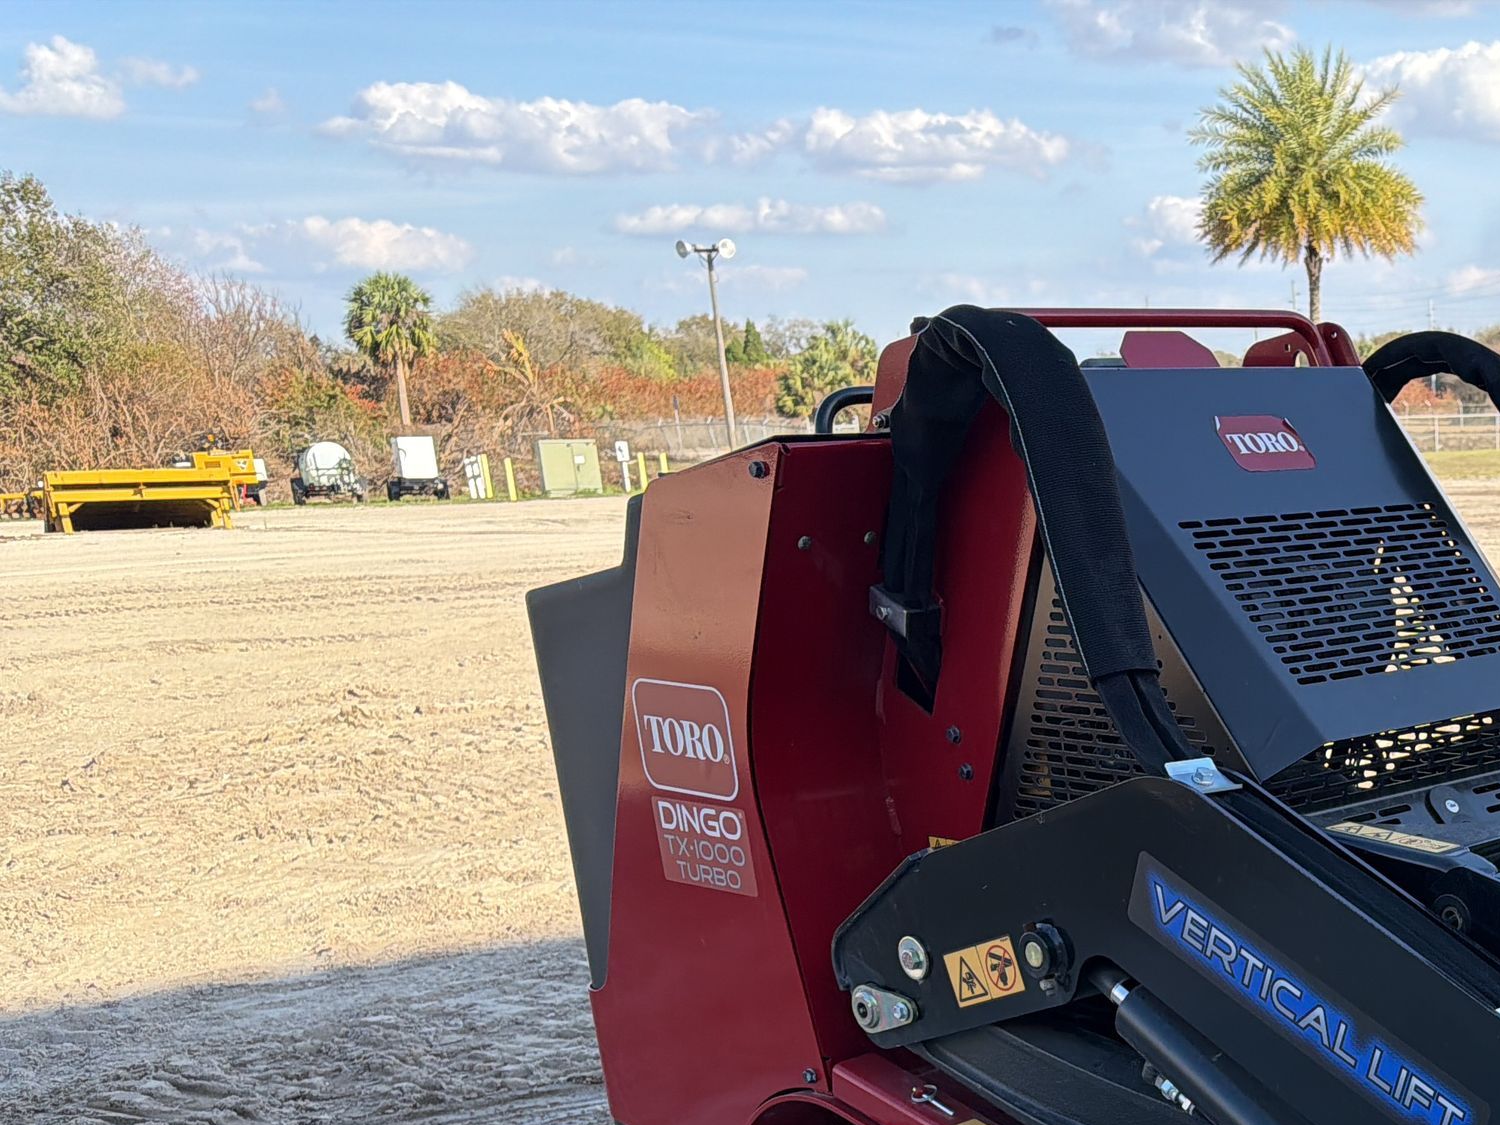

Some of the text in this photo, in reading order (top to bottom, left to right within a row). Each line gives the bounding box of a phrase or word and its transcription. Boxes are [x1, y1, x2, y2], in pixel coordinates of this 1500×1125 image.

[1225, 431, 1299, 455] TORO
[643, 714, 725, 763] TORO
[657, 800, 742, 840] DINGO
[676, 860, 742, 889] TURBO
[1154, 880, 1358, 1068] VERTICAL
